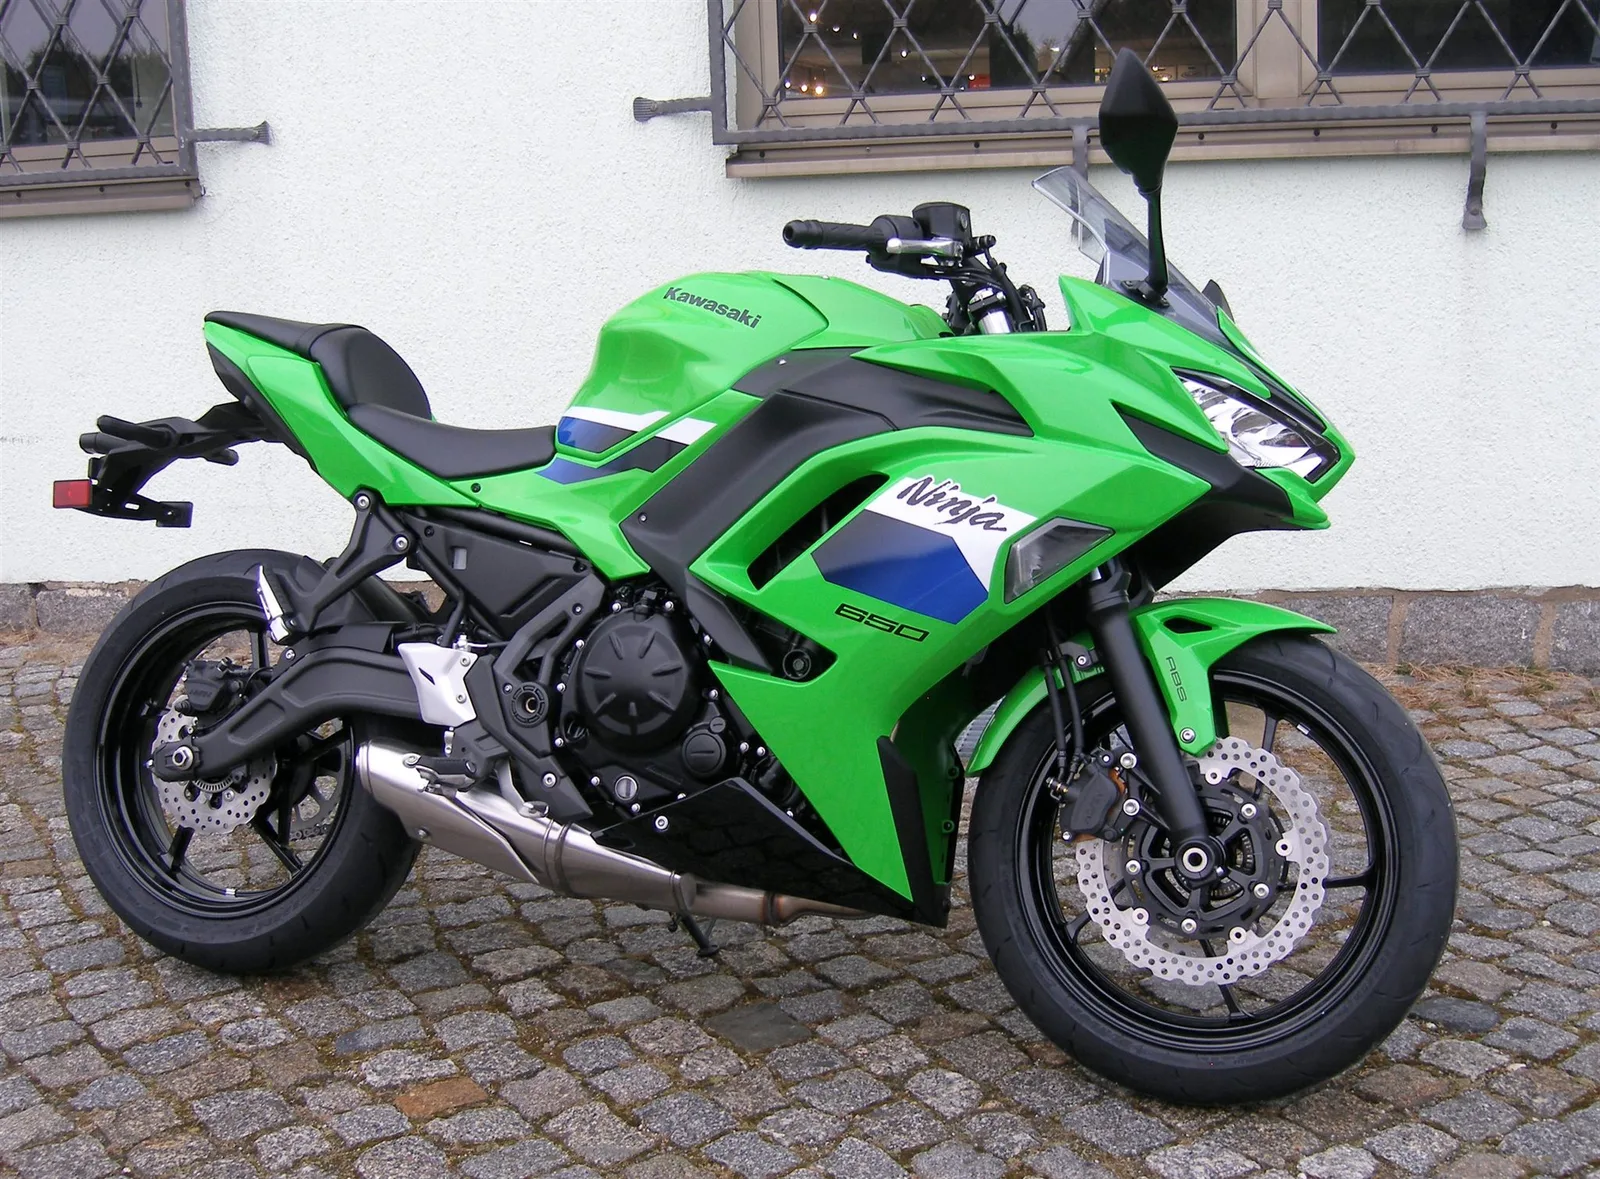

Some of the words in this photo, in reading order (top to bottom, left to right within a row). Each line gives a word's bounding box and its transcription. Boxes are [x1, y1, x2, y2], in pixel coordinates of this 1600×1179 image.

[663, 286, 762, 329] Kawasaki
[897, 476, 1008, 532] Ninja
[834, 603, 930, 642] 650
[1165, 656, 1187, 702] ABS
